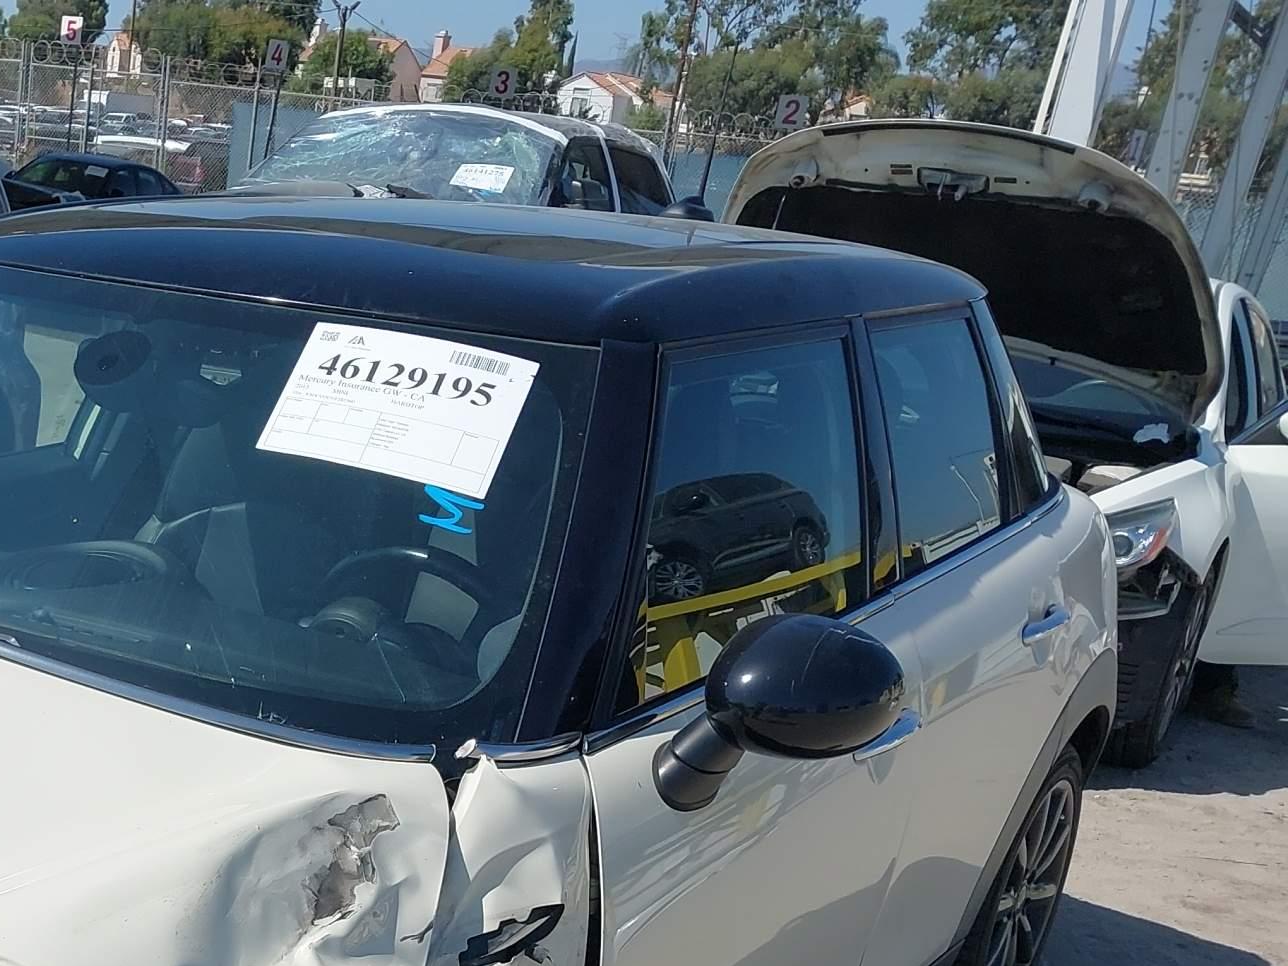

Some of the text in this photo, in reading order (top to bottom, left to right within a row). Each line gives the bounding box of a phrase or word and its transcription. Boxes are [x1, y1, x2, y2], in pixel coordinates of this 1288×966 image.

[66, 20, 77, 41] 5
[271, 44, 282, 65] 4
[495, 71, 510, 94] 3
[782, 100, 801, 125] 2
[298, 374, 336, 387] Mercury
[338, 379, 381, 393] Insurance
[318, 354, 497, 407] 46129195
